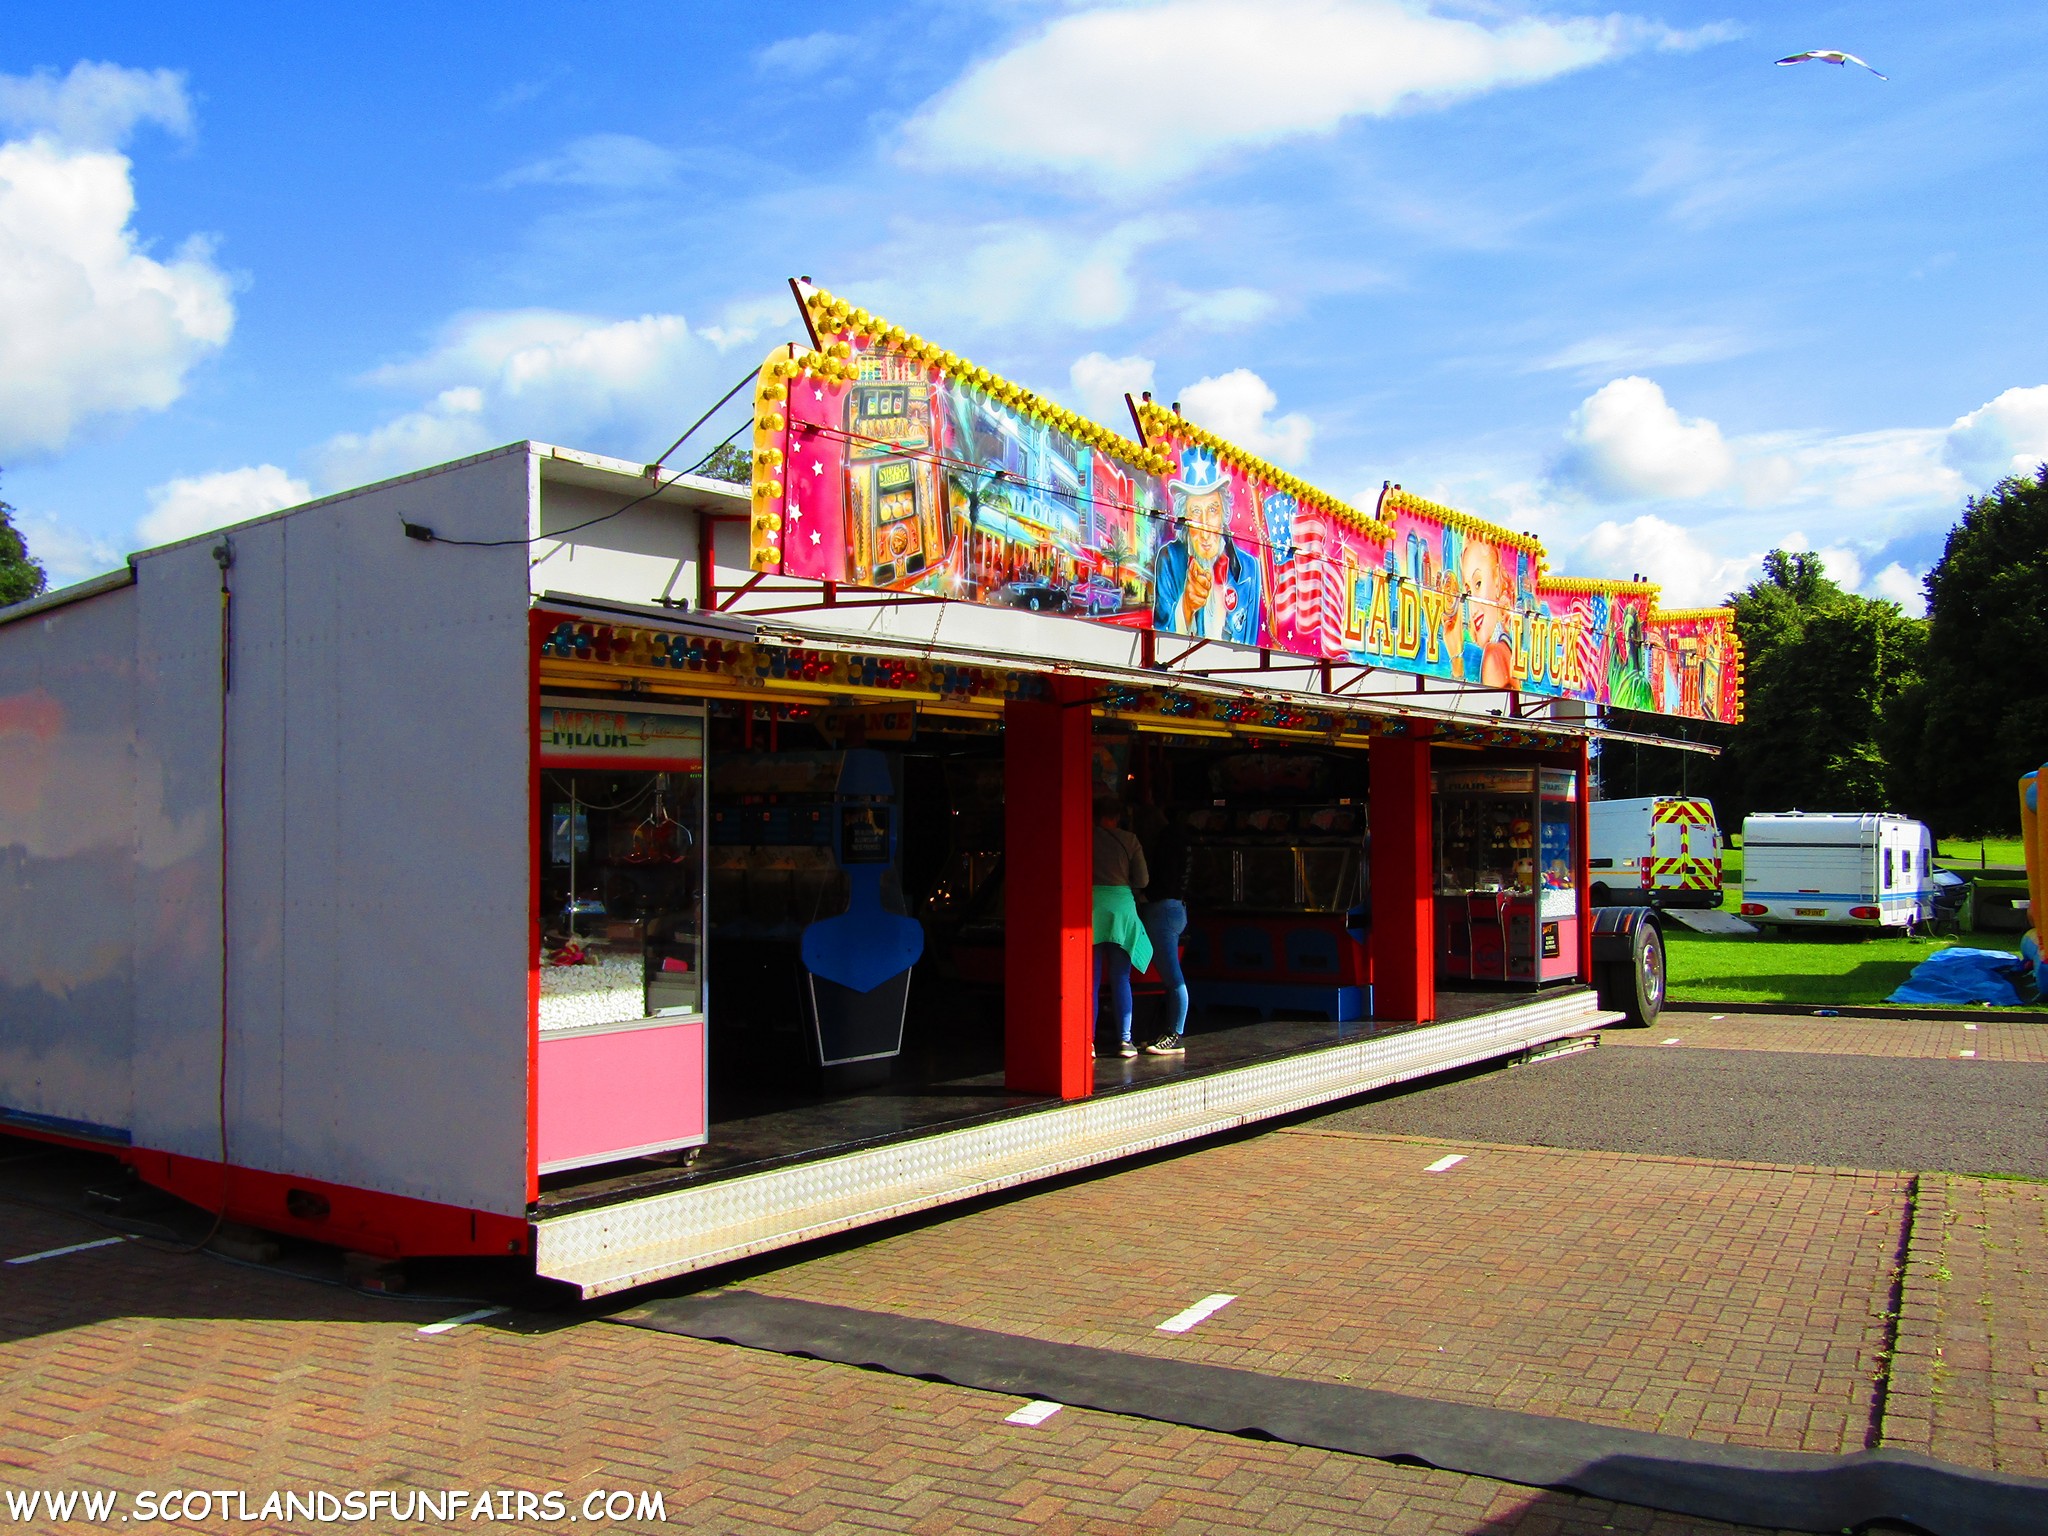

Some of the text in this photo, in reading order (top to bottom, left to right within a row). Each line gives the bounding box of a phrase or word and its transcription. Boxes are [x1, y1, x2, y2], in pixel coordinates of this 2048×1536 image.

[1341, 546, 1582, 691] LADY LUCK
[553, 710, 628, 748] MEGA
[826, 711, 911, 731] CNGE
